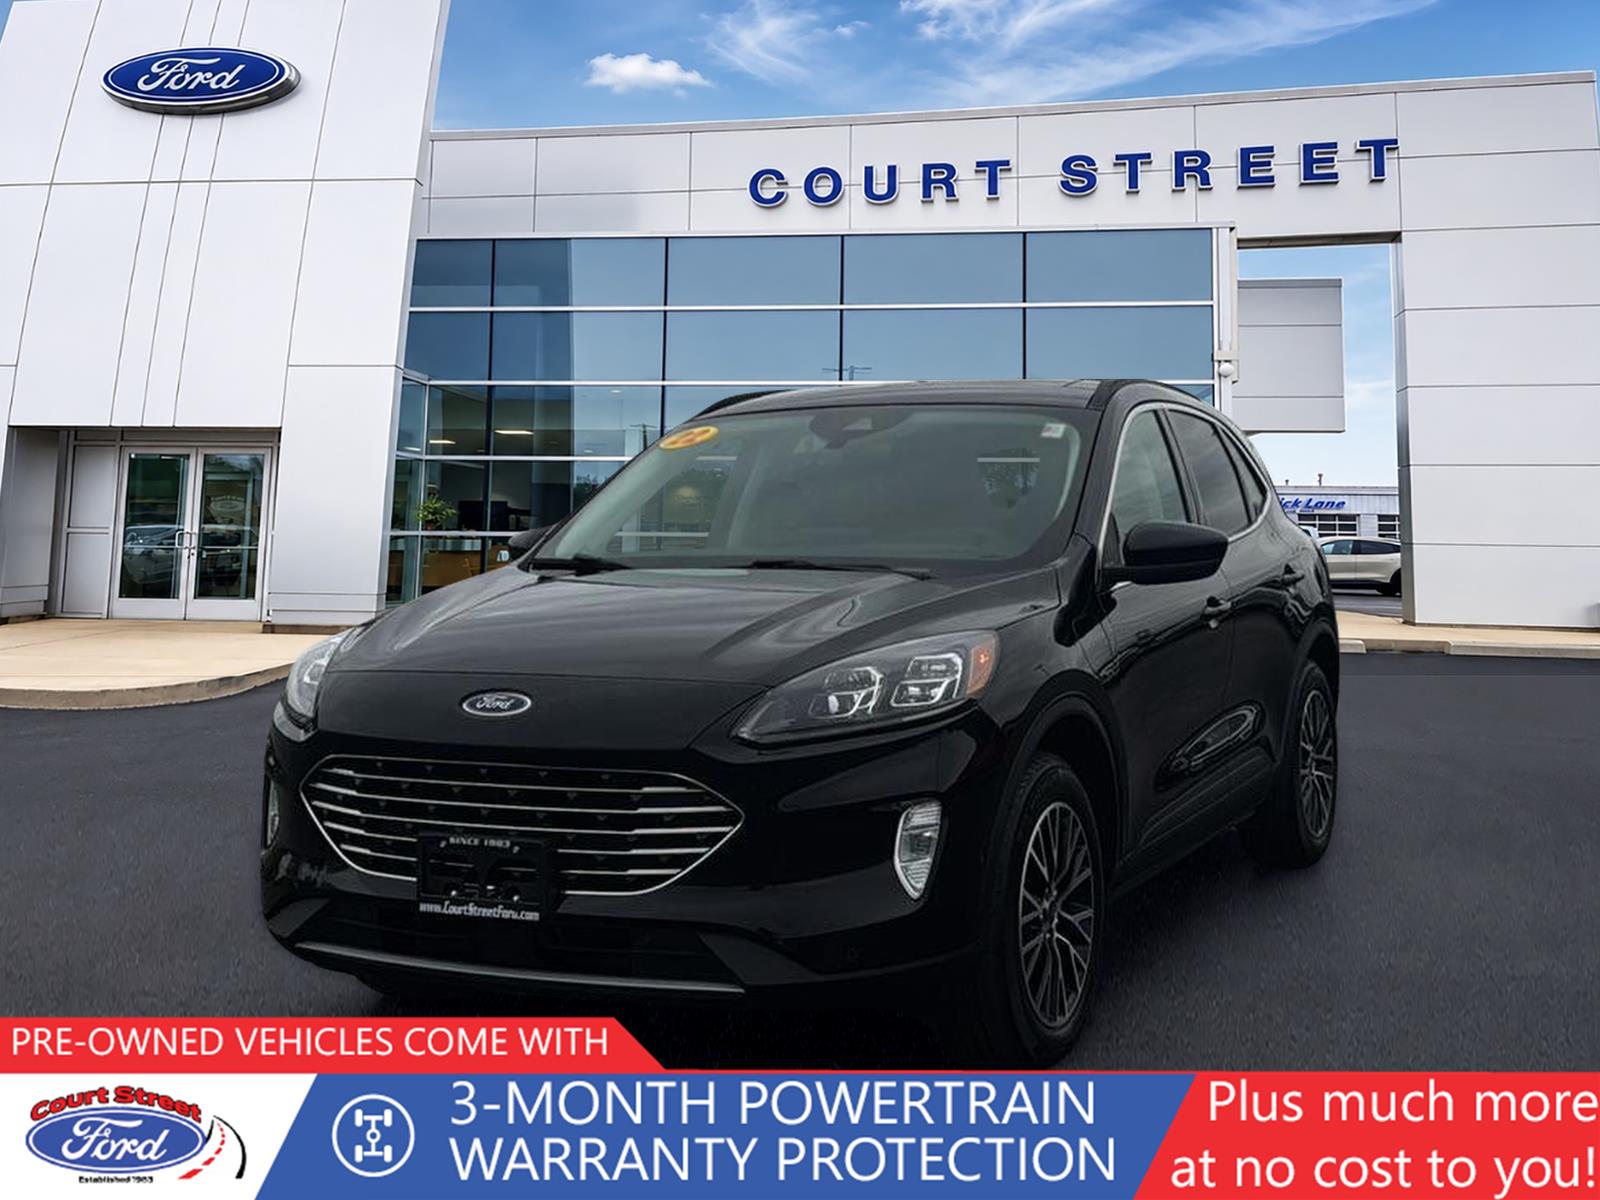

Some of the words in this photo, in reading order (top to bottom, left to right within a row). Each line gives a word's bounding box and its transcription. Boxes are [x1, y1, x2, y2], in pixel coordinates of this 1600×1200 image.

[137, 57, 246, 91] Ford
[748, 159, 1012, 208] COURT
[1059, 137, 1400, 196] STREET
[1281, 497, 1301, 509] ick
[1304, 497, 1346, 510] Lane
